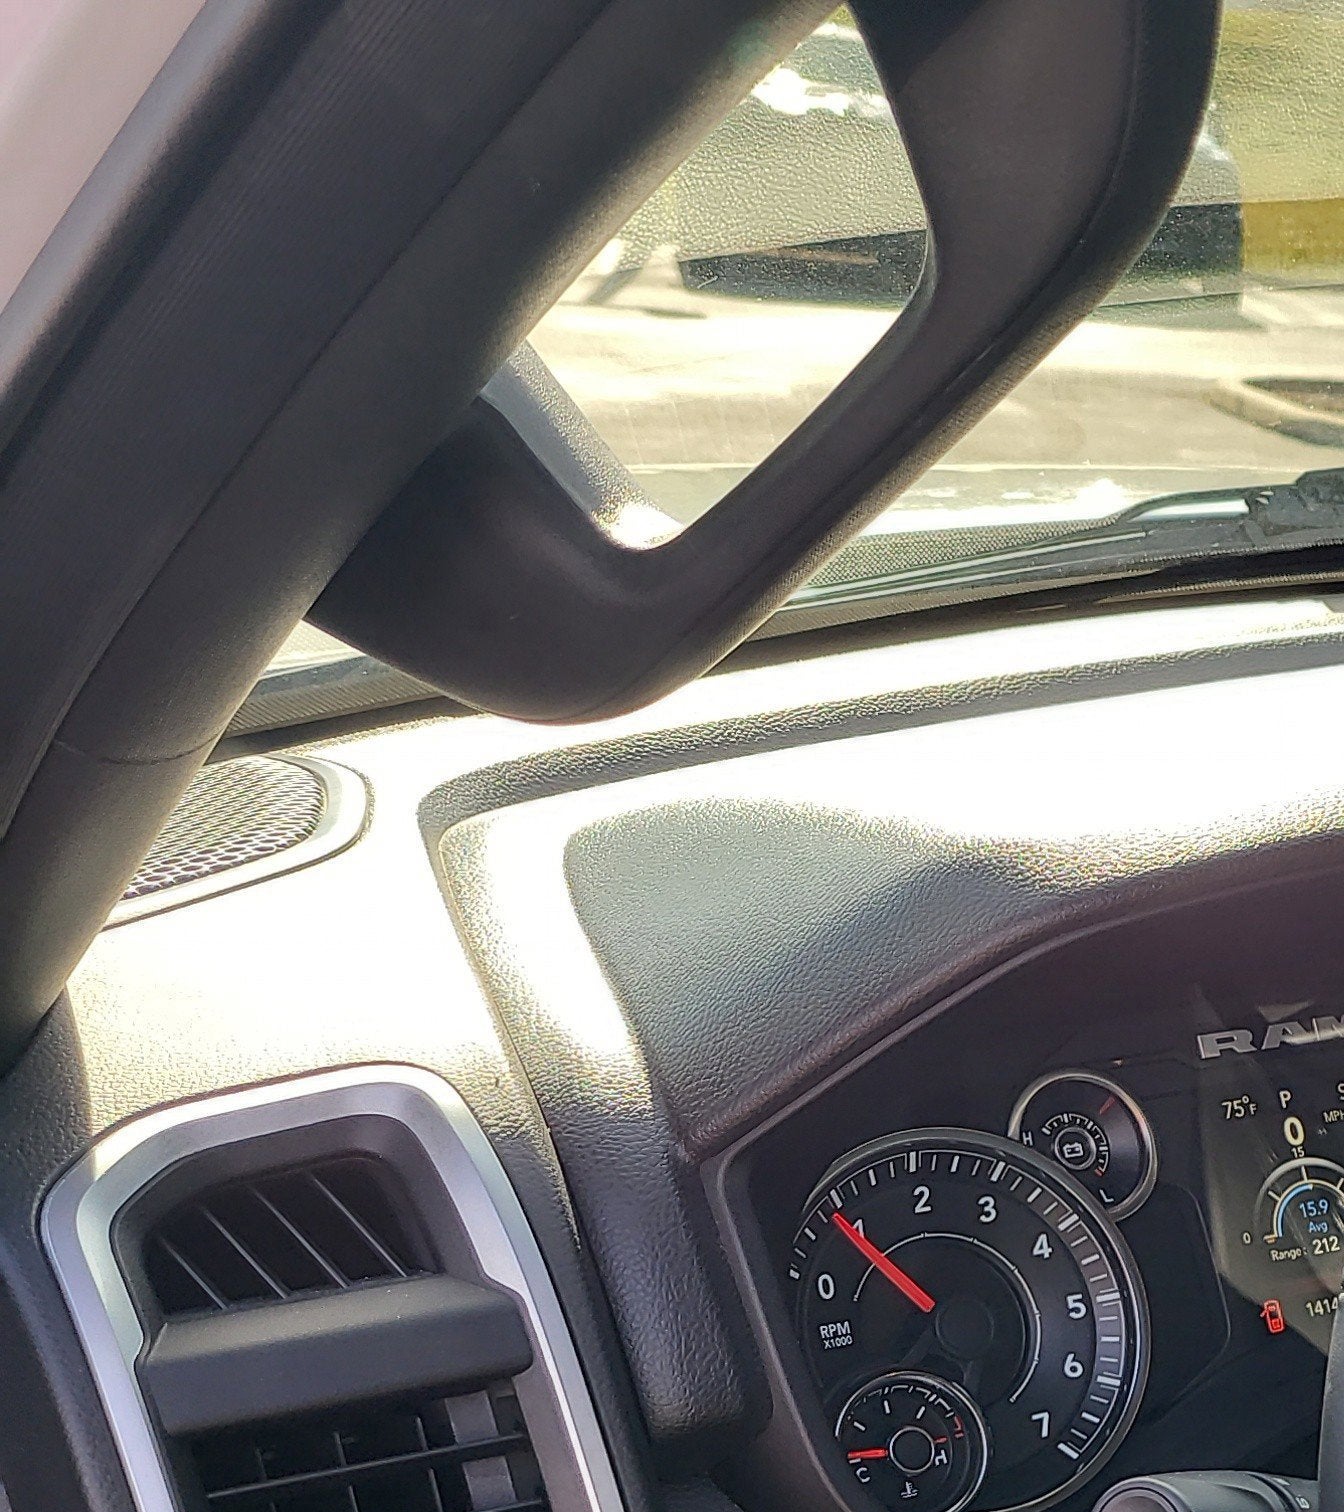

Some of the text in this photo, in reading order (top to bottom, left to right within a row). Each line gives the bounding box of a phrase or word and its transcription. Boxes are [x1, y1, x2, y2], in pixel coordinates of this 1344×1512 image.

[1279, 1090, 1292, 1109] P
[1022, 1131, 1034, 1146] H
[1283, 1116, 1305, 1146] 0
[1291, 1146, 1305, 1158] 15
[913, 1186, 931, 1213] 2
[1100, 1189, 1115, 1203] L
[978, 1196, 997, 1222] 3
[1300, 1199, 1329, 1218] 15.9
[1308, 1221, 1329, 1233] Avg
[1032, 1233, 1052, 1259] 4
[1242, 1232, 1251, 1244] 0
[1312, 1235, 1340, 1255] 212
[817, 1273, 835, 1300] 0
[1066, 1293, 1086, 1319] 5
[820, 1321, 851, 1338] RPM
[824, 1335, 853, 1349] X1000
[1064, 1353, 1084, 1378] 6
[1031, 1411, 1050, 1438] 7
[855, 1467, 871, 1483] C
